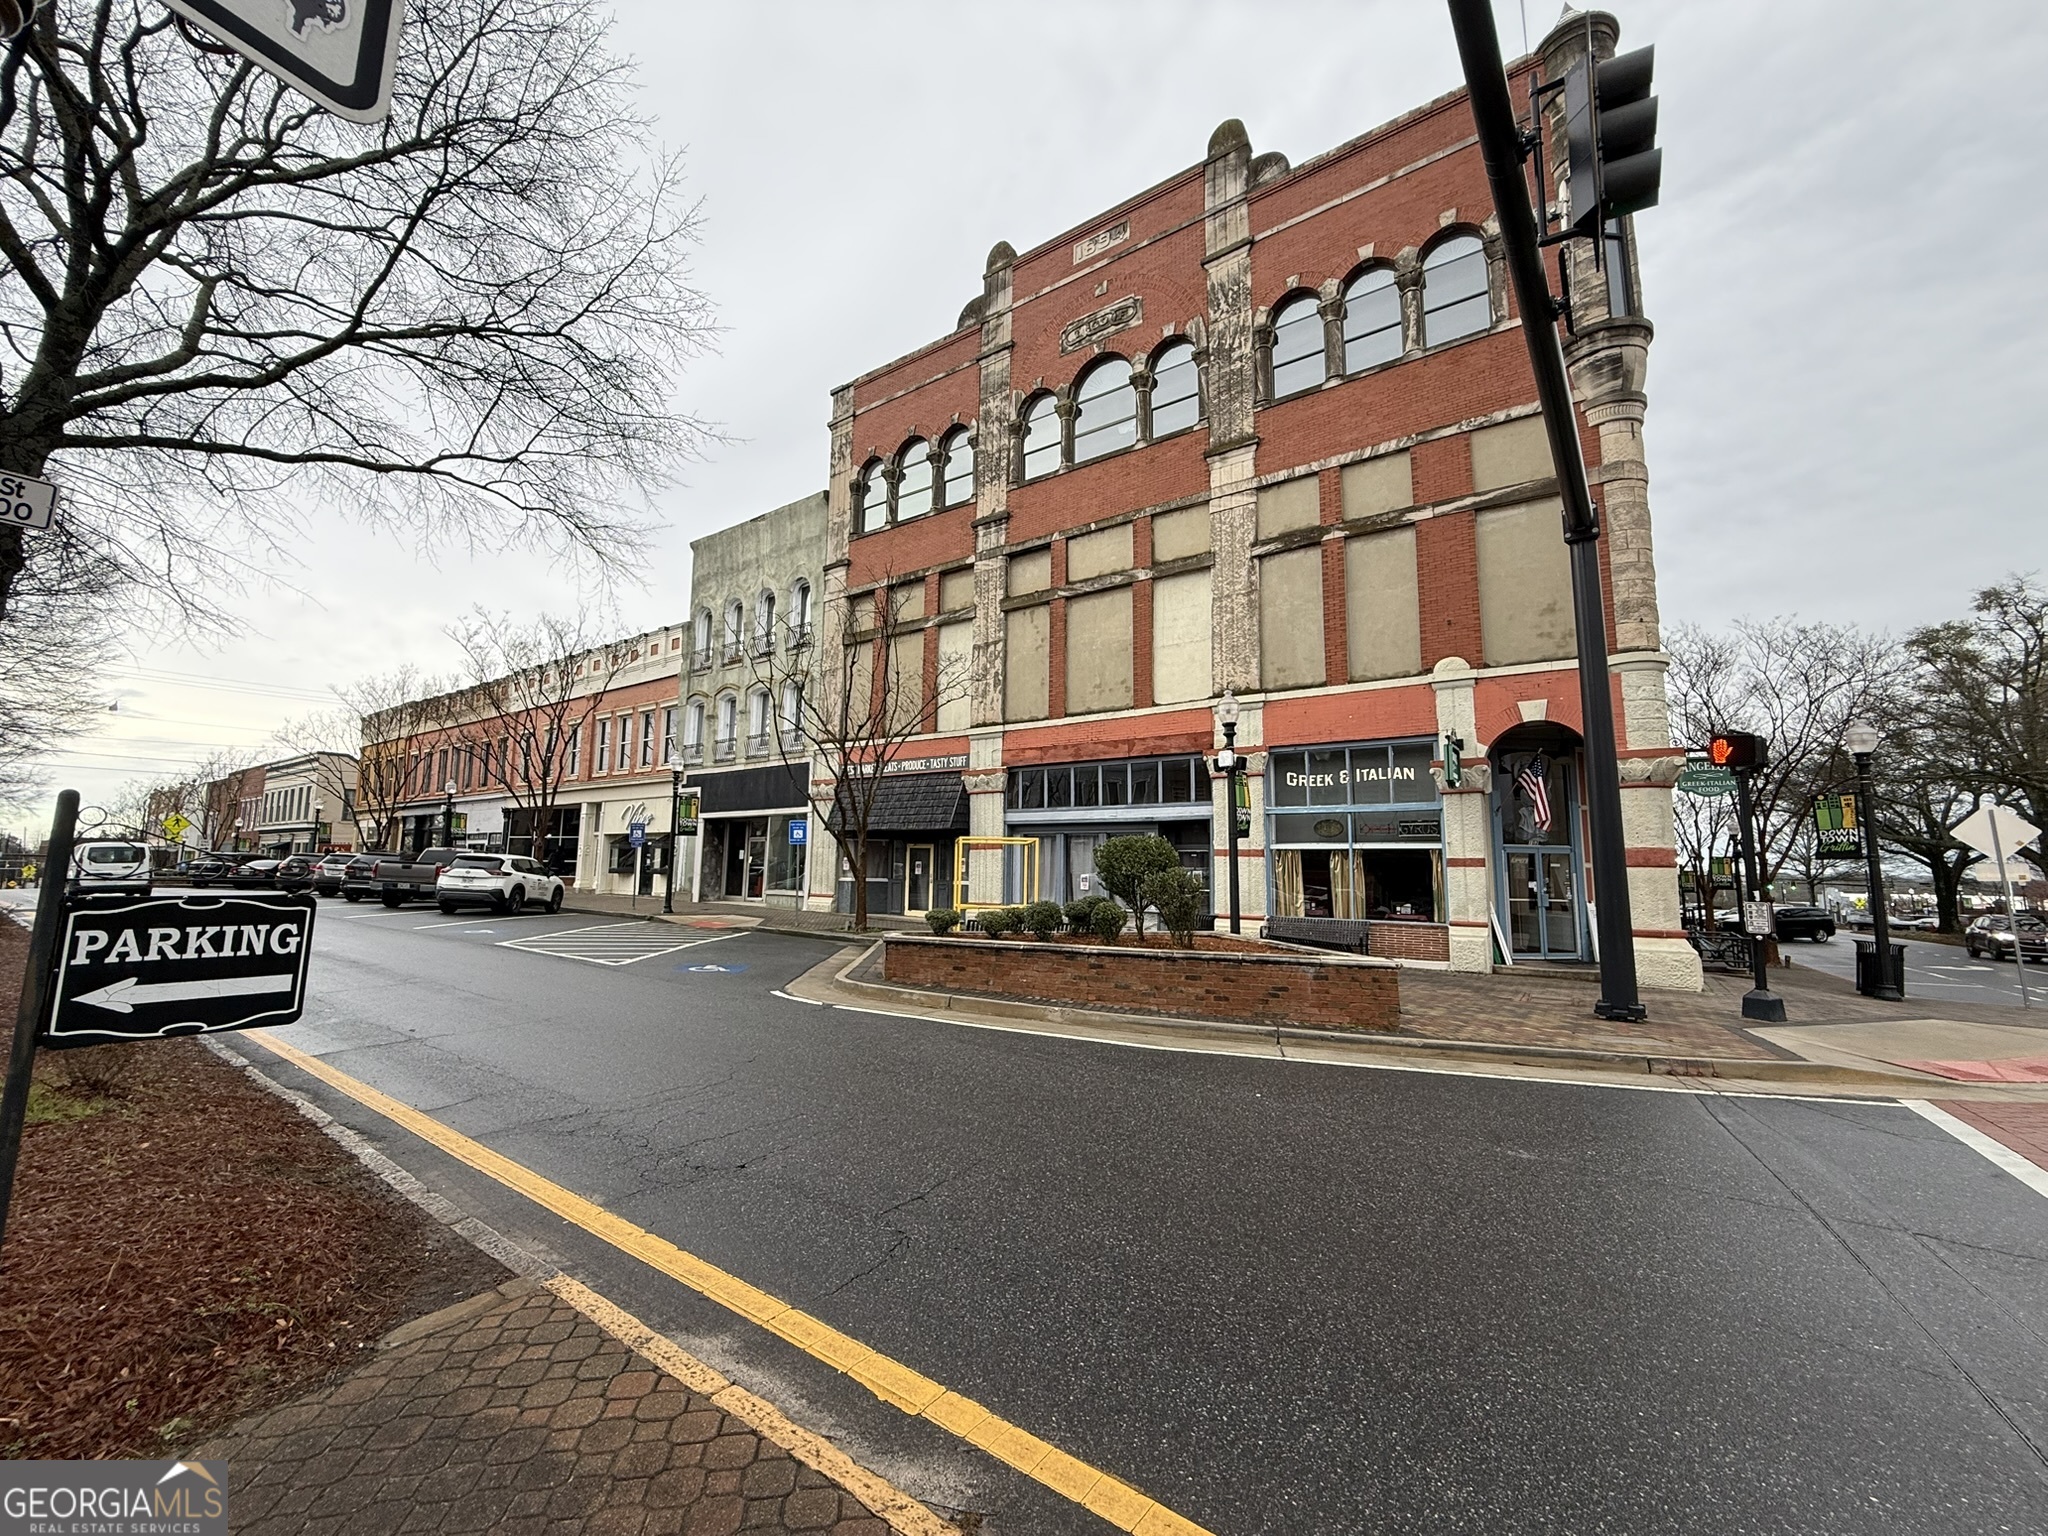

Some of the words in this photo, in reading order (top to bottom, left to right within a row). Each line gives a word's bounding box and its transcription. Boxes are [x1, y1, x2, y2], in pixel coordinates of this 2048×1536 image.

[1077, 222, 1127, 261] 1894
[0, 477, 26, 499] St
[881, 761, 898, 773] EATS
[901, 759, 927, 771] PRODUCE
[930, 757, 948, 769] TASTY
[949, 755, 967, 768] STUFF
[1286, 771, 1334, 787] GREEK
[1339, 769, 1350, 784] &
[1356, 766, 1415, 783] ITALIAN
[1819, 828, 1858, 838] DOWN
[1820, 835, 1859, 844] TOWN
[70, 923, 301, 966] PARKING
